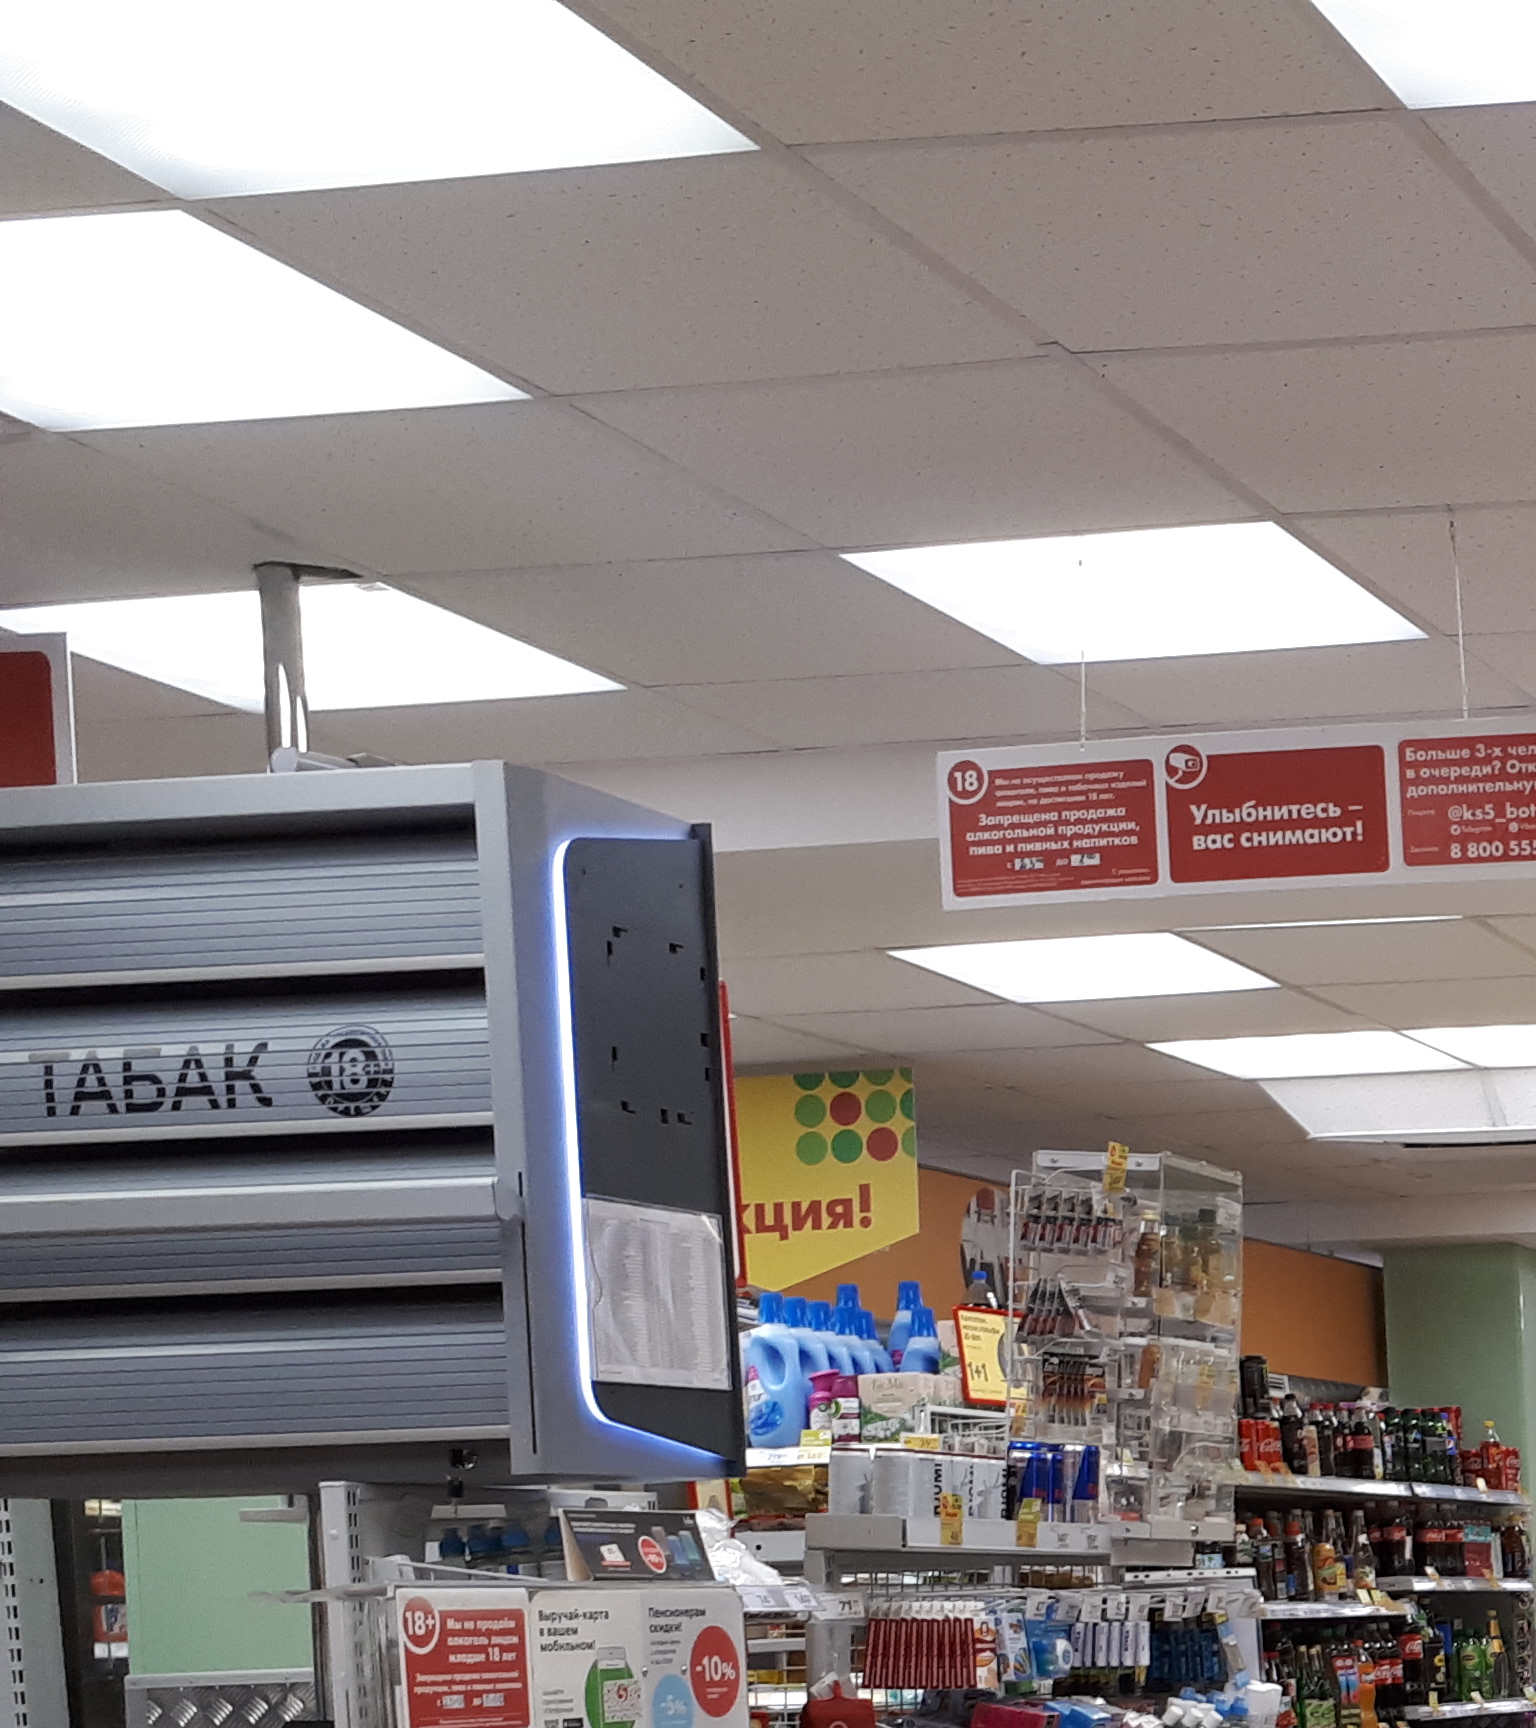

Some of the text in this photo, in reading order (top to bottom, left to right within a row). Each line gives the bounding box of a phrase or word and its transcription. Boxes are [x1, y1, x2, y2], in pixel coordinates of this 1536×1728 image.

[1405, 747, 1470, 761] Больше
[1475, 744, 1504, 757] 3-х
[954, 770, 979, 791] 18
[1405, 768, 1415, 779] в
[1420, 761, 1501, 780] очереди?
[978, 807, 1126, 827] Запрещена продажа
[1189, 800, 1342, 825] Улыбнитесь
[966, 820, 1140, 842] алкогольной продукции,
[1192, 820, 1363, 850] вас снимают!
[969, 835, 1138, 856] пива и пивных напитков
[1451, 843, 1462, 859] 8
[1467, 842, 1503, 858] 800
[28, 1042, 273, 1118] ТАБАК
[405, 1611, 435, 1635] 18+
[538, 1608, 609, 1624] Выручай-карта
[488, 1647, 500, 1661] 18
[695, 1655, 736, 1682] -10%
